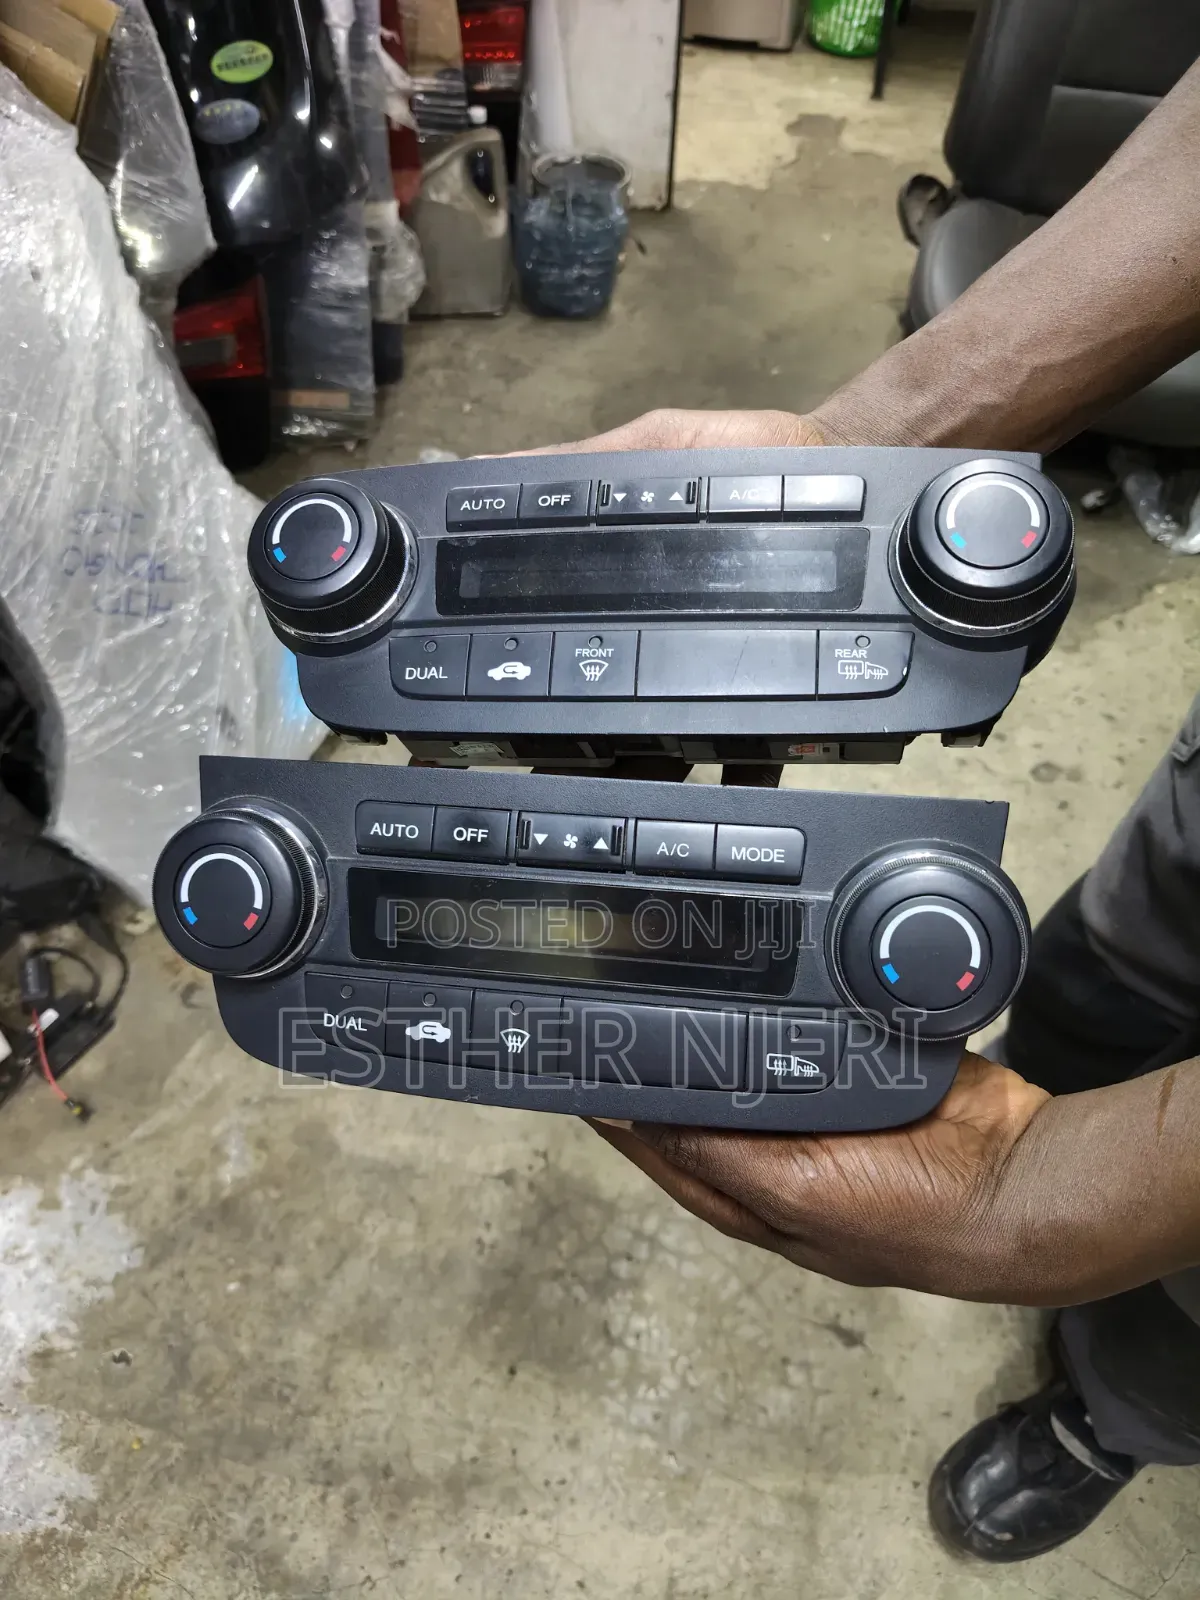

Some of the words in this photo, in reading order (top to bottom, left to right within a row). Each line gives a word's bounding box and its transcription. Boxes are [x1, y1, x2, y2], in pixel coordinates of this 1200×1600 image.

[460, 498, 505, 511] AUTO
[538, 494, 571, 507] OFF
[575, 648, 614, 658] FRONT
[835, 649, 868, 659] REAR
[405, 666, 448, 680] DUAL
[370, 822, 419, 840] AUTO
[453, 827, 489, 843] OFF
[656, 841, 690, 858] A/C
[731, 846, 785, 863] MODE
[323, 1013, 367, 1032] DUAL
